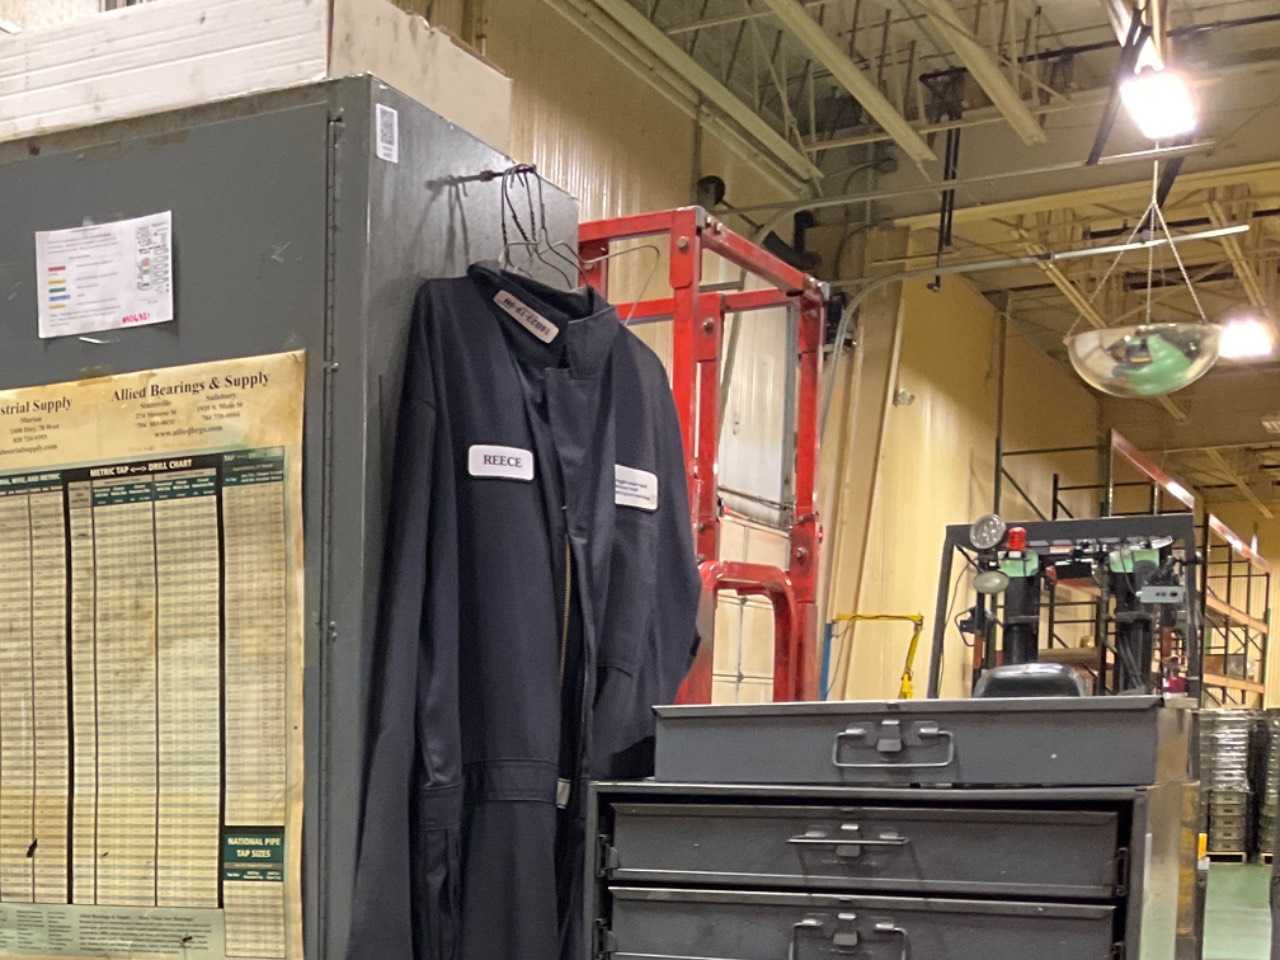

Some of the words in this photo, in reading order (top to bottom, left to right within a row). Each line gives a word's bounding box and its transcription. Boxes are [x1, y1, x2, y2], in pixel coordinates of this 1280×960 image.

[112, 387, 146, 401] Allied
[150, 380, 205, 397] Bearings
[208, 377, 220, 390] &
[224, 371, 269, 388] Supply
[33, 396, 73, 411] Supply
[90, 467, 116, 477] METRIC
[116, 465, 129, 474] TAP
[149, 461, 168, 471] DRILL
[169, 459, 192, 469] CHART
[483, 454, 523, 468] REECE
[228, 837, 263, 845] NATIONAL
[264, 837, 281, 845] PIPE
[236, 849, 250, 857] TAP
[251, 849, 271, 857] SIZES
